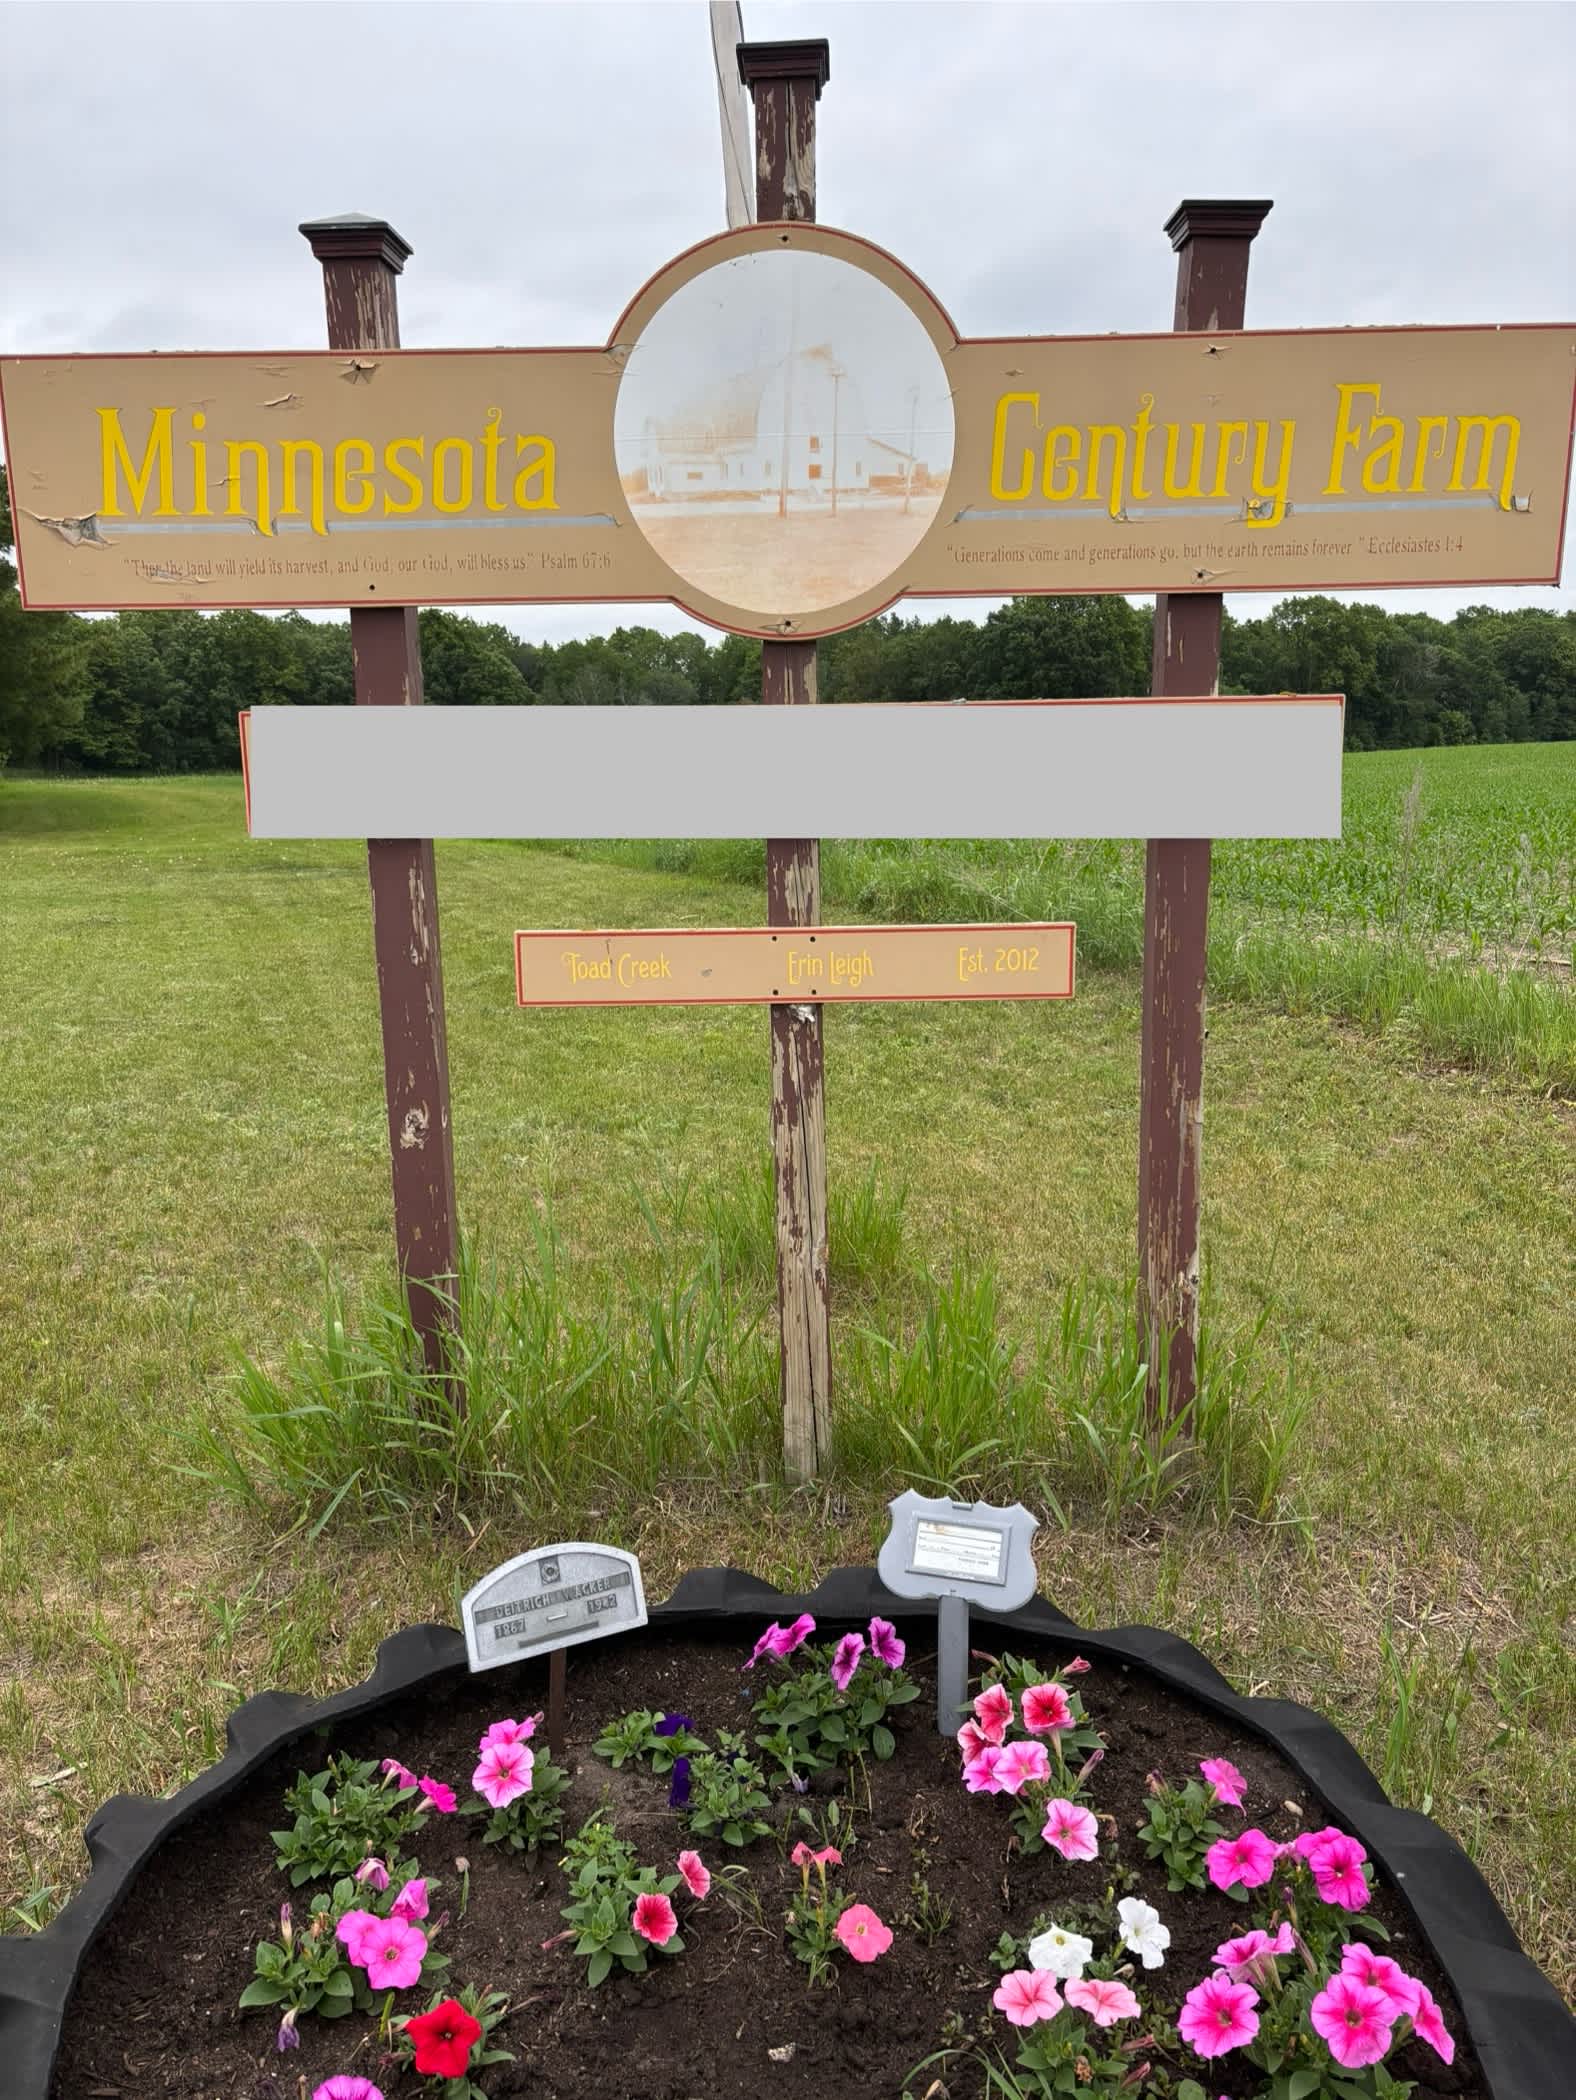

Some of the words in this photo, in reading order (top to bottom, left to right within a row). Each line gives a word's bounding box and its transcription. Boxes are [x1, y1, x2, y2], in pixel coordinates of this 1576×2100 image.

[95, 406, 560, 536] Minnesota
[990, 392, 1296, 528] Century
[1322, 383, 1522, 512] Farm
[165, 559, 182, 577] the
[186, 559, 211, 576] land
[216, 558, 236, 575] will
[240, 557, 266, 579] yield
[269, 558, 282, 575] its
[286, 559, 333, 577] harvest,
[338, 558, 358, 573] and
[399, 560, 418, 572] our
[422, 554, 453, 575] God,
[457, 552, 477, 571] will
[481, 553, 509, 571] bless
[541, 552, 578, 569] Psalm
[582, 552, 611, 569] 67:6
[947, 545, 1025, 563] "Generations
[1029, 549, 1059, 561] come
[1064, 544, 1085, 560] and
[1089, 544, 1156, 565] generations
[1184, 544, 1201, 558] but
[1206, 544, 1222, 559] the
[1227, 543, 1258, 558] earth
[1262, 539, 1308, 557] remains
[1368, 535, 1440, 554] Ecclesiastes
[1445, 535, 1463, 552] 1:4
[561, 952, 611, 984] Toad
[618, 952, 672, 988] Creek
[787, 951, 823, 985] Erin
[829, 949, 874, 987] Leigh
[957, 946, 988, 982] Est.
[994, 946, 1040, 972] 2012
[495, 1619, 526, 1638] 1867
